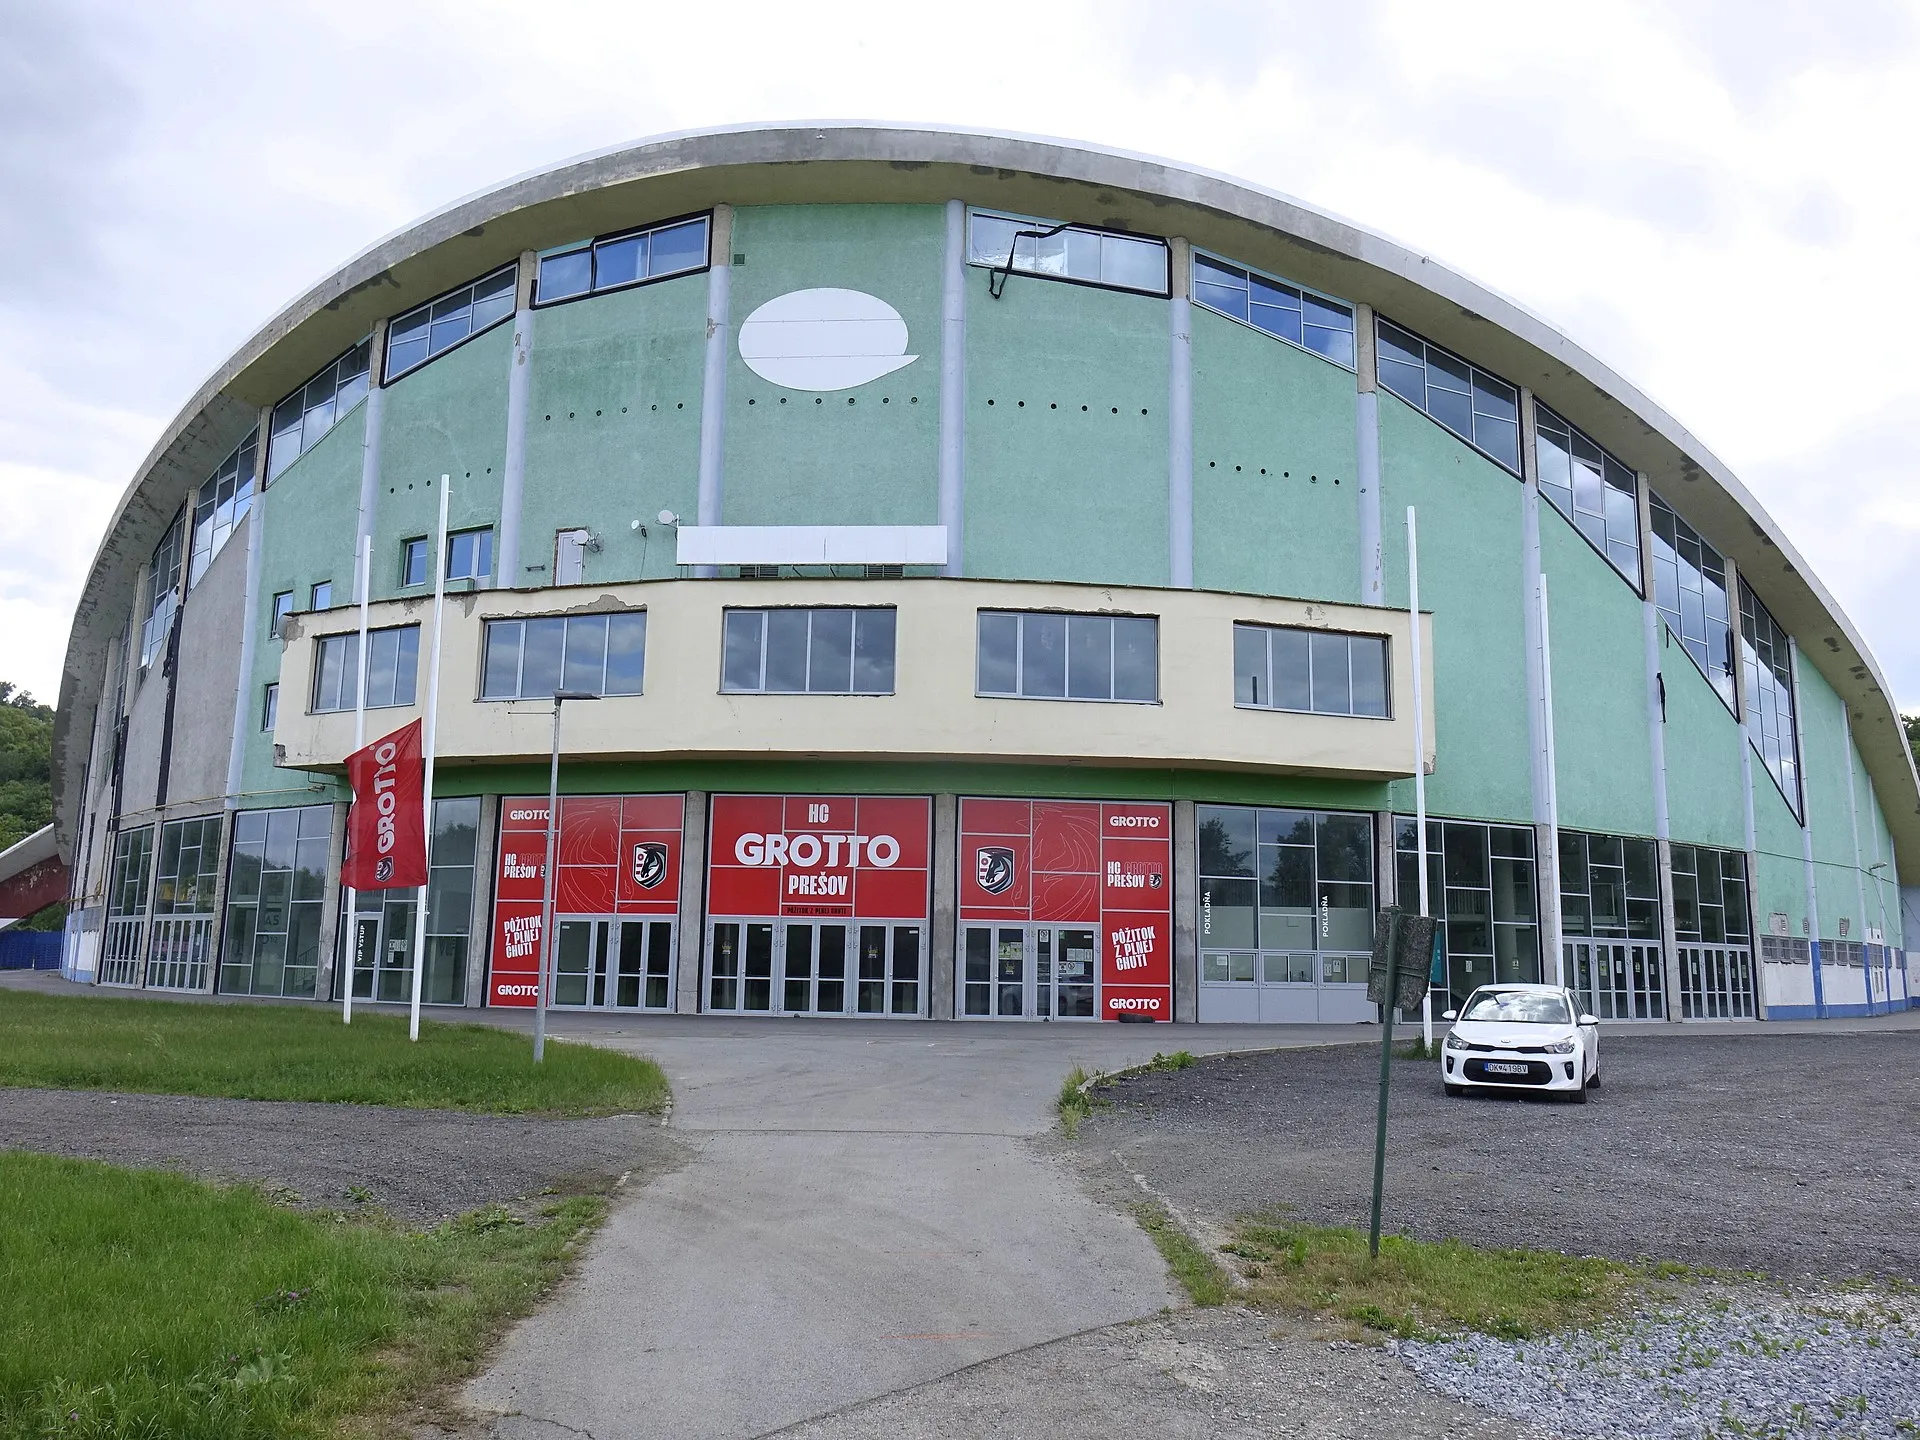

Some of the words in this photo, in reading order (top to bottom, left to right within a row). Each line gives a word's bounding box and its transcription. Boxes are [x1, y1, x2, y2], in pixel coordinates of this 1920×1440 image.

[510, 810, 550, 820] GROTTO
[808, 803, 830, 824] HC
[1110, 815, 1160, 828] GROTTO
[734, 832, 900, 868] GROTTO
[505, 853, 517, 866] HC
[1107, 861, 1121, 874] HC
[503, 863, 537, 879] PREŠOV
[1107, 872, 1145, 888] PREŠOV
[788, 871, 848, 896] PREŠOV
[1203, 891, 1211, 935] POKLADŇA
[504, 914, 542, 934] PÔŽITOK
[505, 933, 512, 946] Z
[513, 928, 539, 945] PLNEJ
[1111, 925, 1156, 946] PÔŽITOK
[506, 941, 533, 959] CHUTI
[1113, 944, 1122, 958] Z
[1124, 939, 1154, 957] PLNEJ
[1116, 953, 1148, 971] CHUTI
[497, 984, 539, 997] GROTTO
[1109, 998, 1160, 1010] GROTTO
